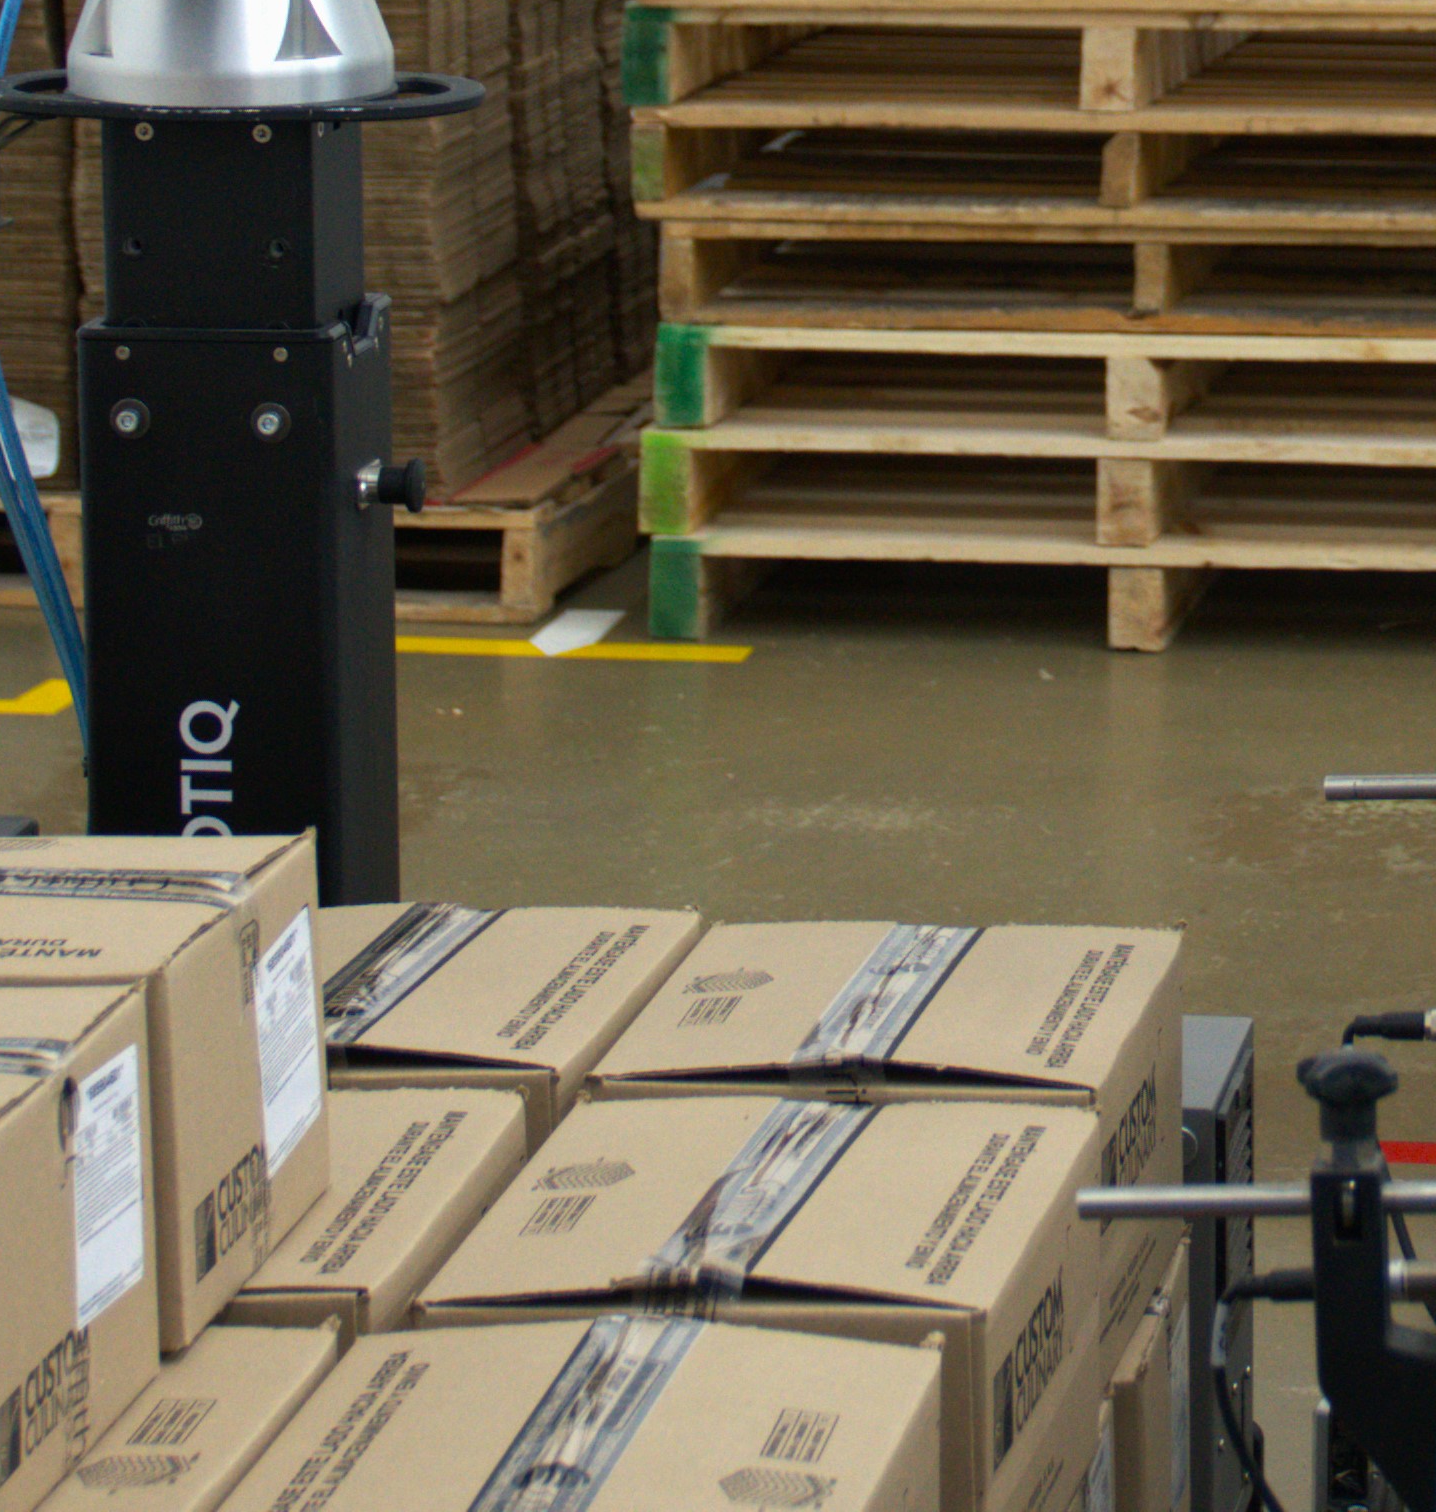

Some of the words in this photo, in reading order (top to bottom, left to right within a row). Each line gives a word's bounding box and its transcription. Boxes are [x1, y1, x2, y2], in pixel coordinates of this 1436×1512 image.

[1119, 1061, 1157, 1166] CUSTOM
[218, 1143, 267, 1222] CUSTO
[1015, 1266, 1065, 1388] CUSTOM
